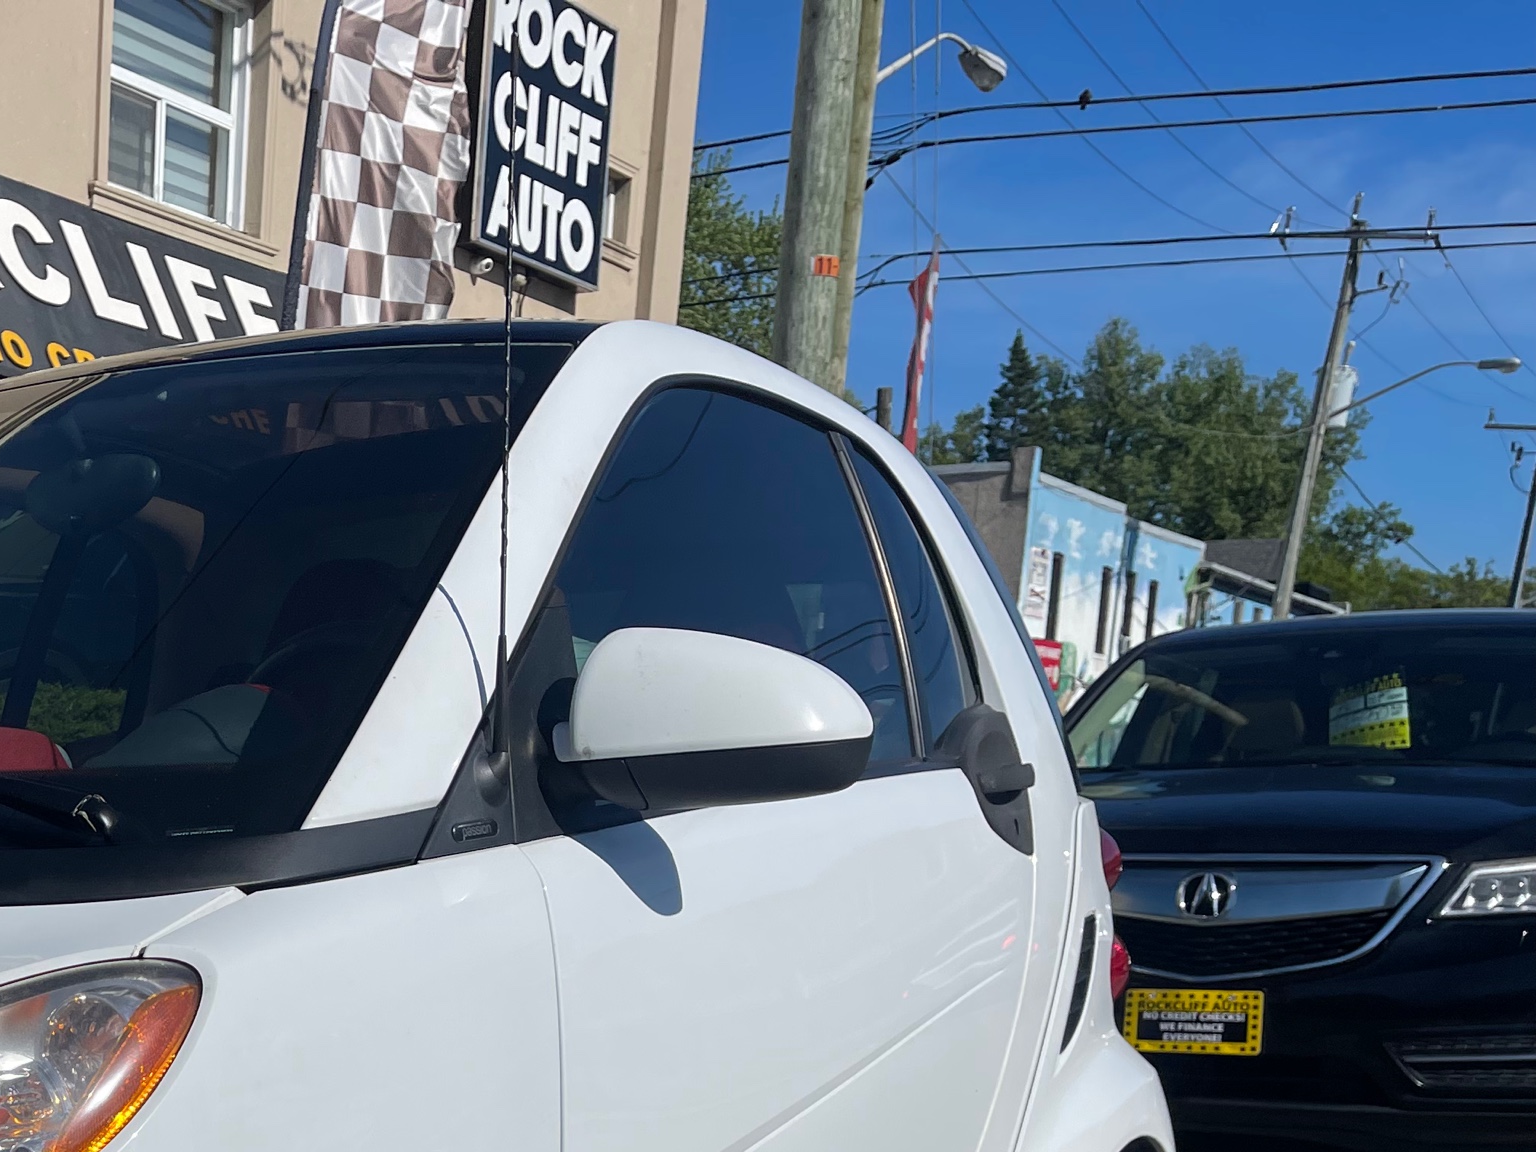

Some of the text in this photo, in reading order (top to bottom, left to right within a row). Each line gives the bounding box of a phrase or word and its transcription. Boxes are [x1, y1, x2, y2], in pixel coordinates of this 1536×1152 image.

[492, 0, 614, 106] ROCK
[493, 71, 603, 188] CLIFF
[485, 164, 595, 274] AUTO
[1138, 1000, 1250, 1011] ROCKCLIFF AUTO
[1143, 1011, 1159, 1020] NO
[1160, 1011, 1198, 1021] CREDIT
[1159, 1022, 1225, 1032] WE FINANCE
